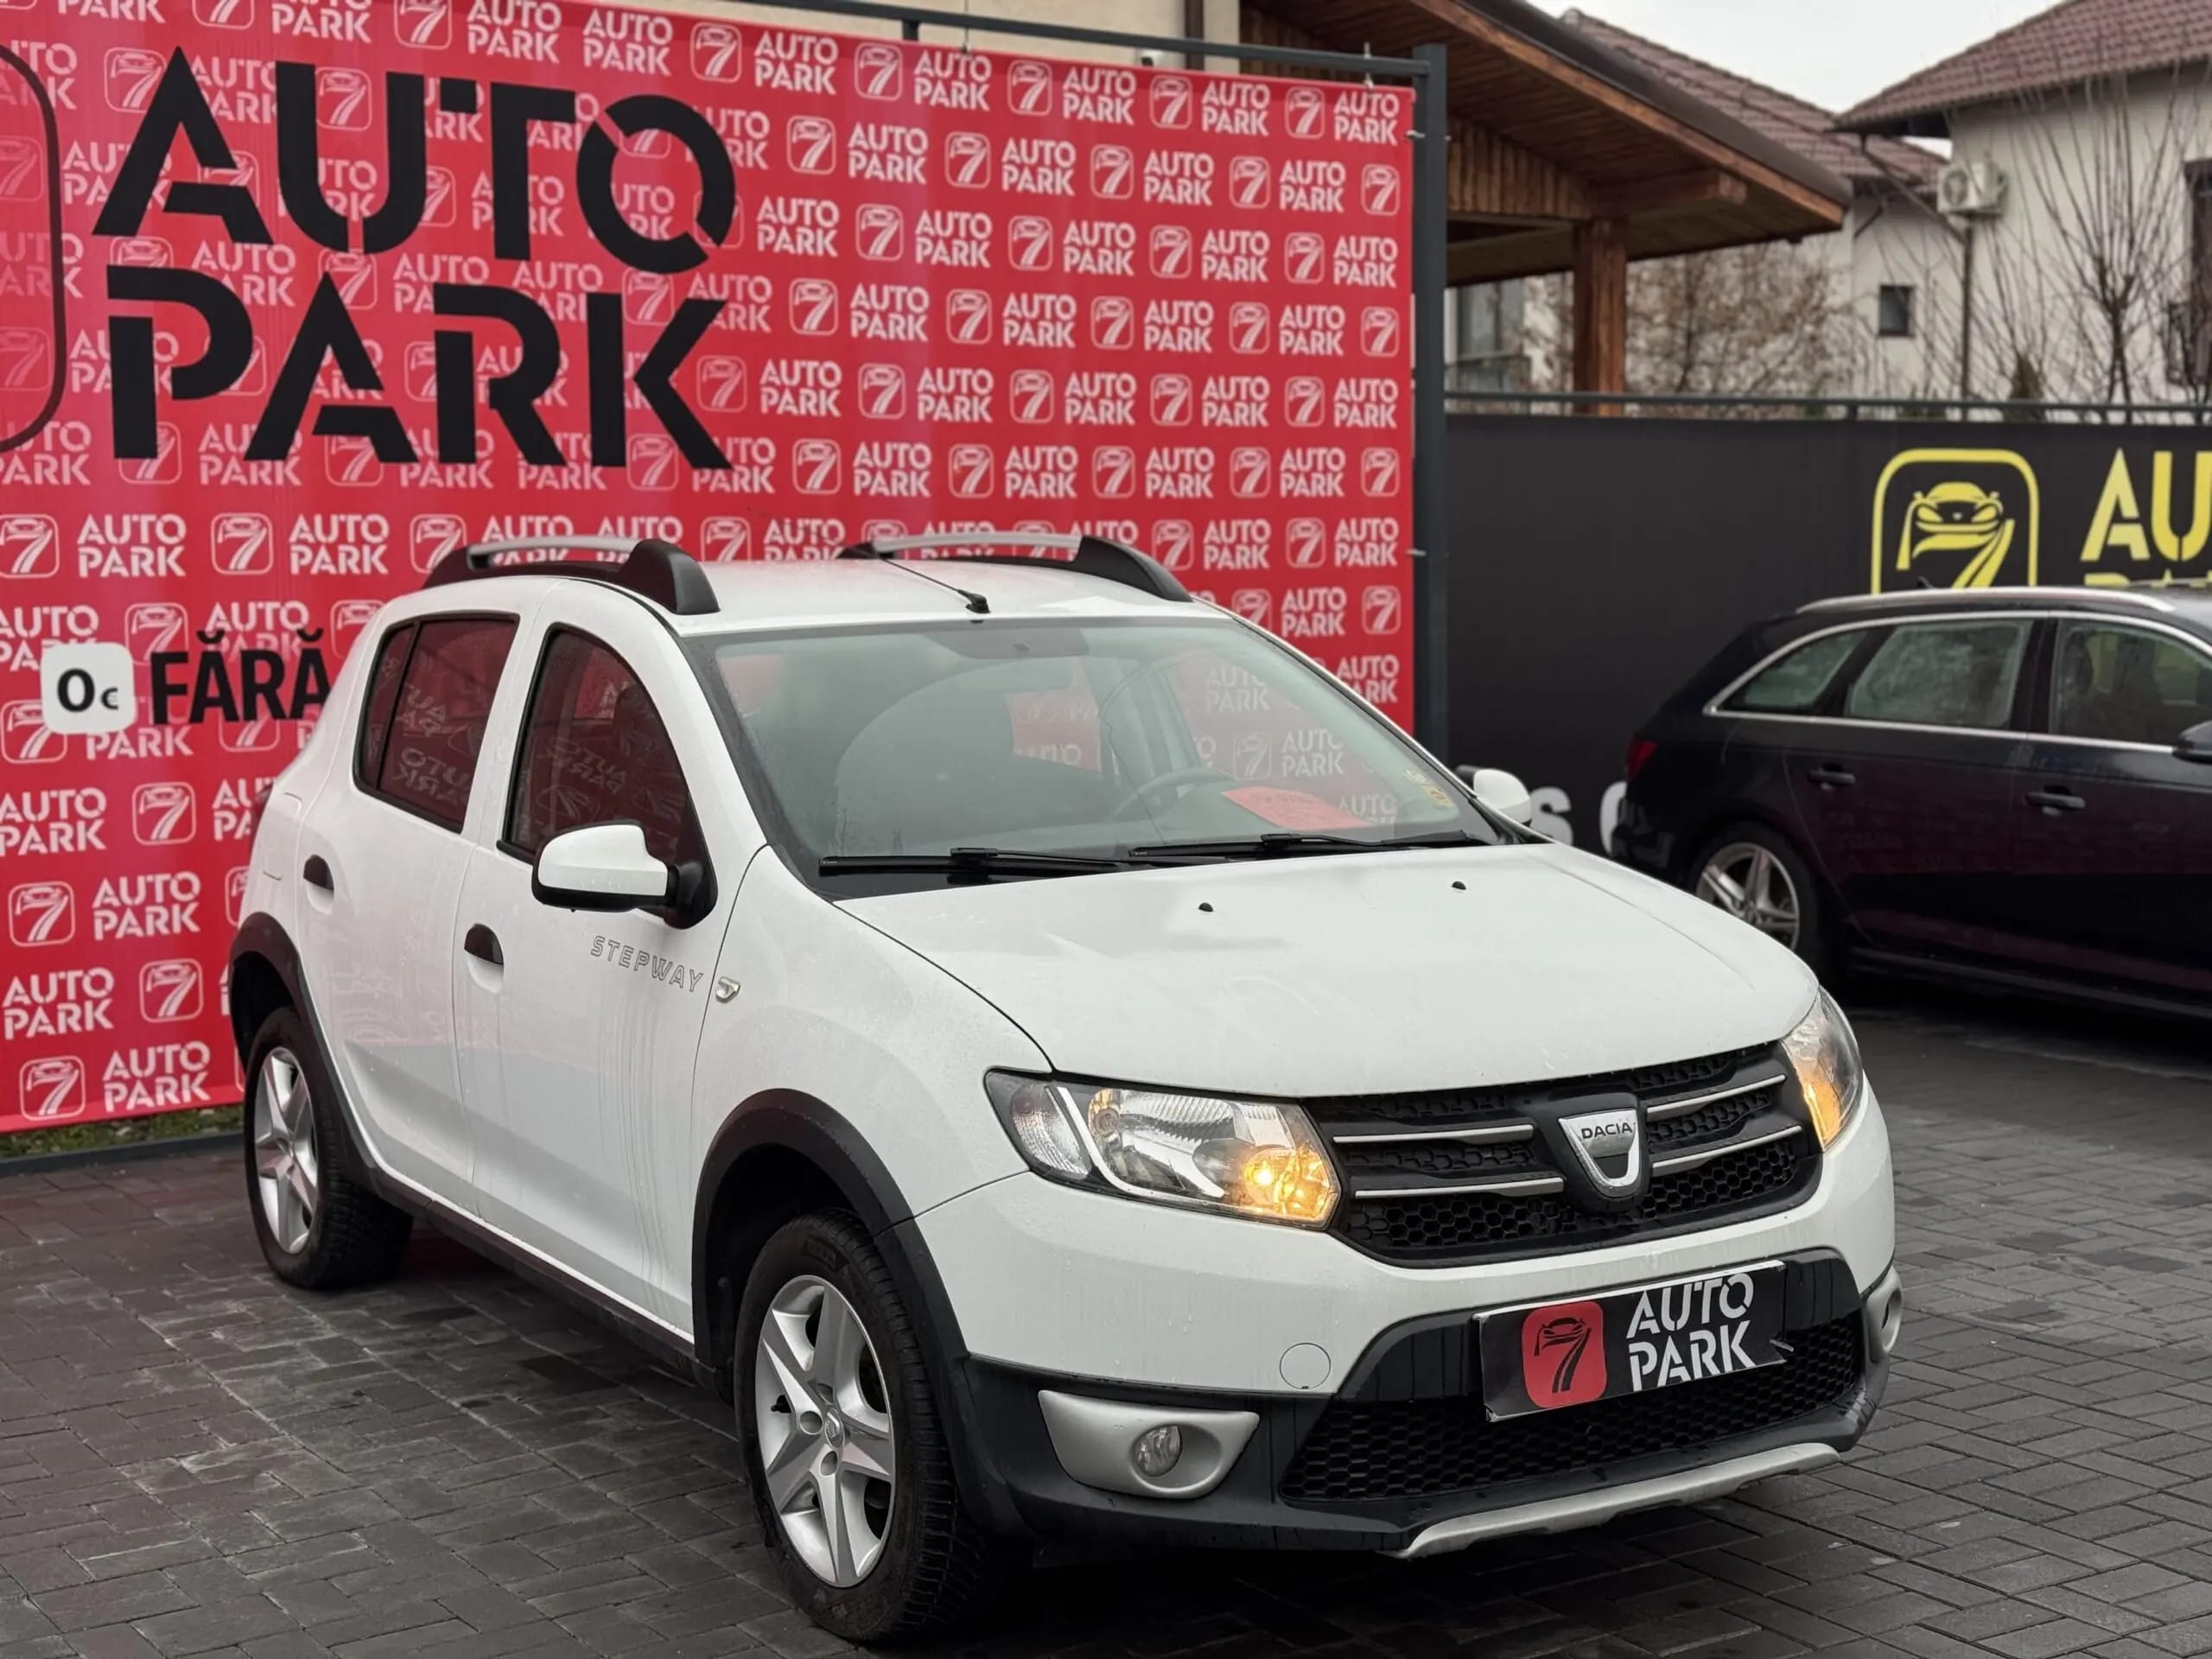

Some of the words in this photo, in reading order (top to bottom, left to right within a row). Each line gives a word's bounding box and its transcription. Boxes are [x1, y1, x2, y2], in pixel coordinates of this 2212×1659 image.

[271, 7, 372, 43] PARK
[467, 0, 562, 33] AUTO
[583, 9, 672, 45] AUTO
[467, 25, 560, 63] PARK
[584, 37, 671, 76] PARK
[755, 31, 837, 64] AUTO
[755, 58, 836, 94] PARK
[915, 50, 991, 83] AUTO
[915, 76, 989, 111] PARK
[1064, 66, 1136, 98] AUTO
[1203, 79, 1270, 110] AUTO
[1064, 92, 1134, 124] PARK
[1335, 91, 1399, 118] AUTO
[1203, 105, 1268, 136] PARK
[1335, 115, 1397, 145] PARK
[849, 123, 928, 156] AUTO
[1002, 138, 1076, 168] AUTO
[92, 47, 735, 273] AUTO
[849, 149, 926, 184] PARK
[1144, 150, 1214, 179] AUTO
[1280, 161, 1345, 188] AUTO
[1002, 164, 1074, 195] PARK
[1144, 175, 1211, 206] PARK
[757, 197, 839, 228] AUTO
[1280, 184, 1344, 213] PARK
[915, 211, 992, 240] AUTO
[1064, 221, 1135, 249] AUTO
[758, 224, 837, 257] PARK
[916, 236, 990, 267] PARK
[1202, 230, 1269, 257] AUTO
[1333, 236, 1398, 262] AUTO
[191, 241, 296, 275] AUTO
[393, 253, 489, 287] AUTO
[1064, 245, 1134, 276] PARK
[1202, 253, 1268, 282] PARK
[512, 260, 603, 292] AUTO
[689, 273, 772, 302] AUTO
[1334, 260, 1396, 288] PARK
[850, 283, 929, 314] AUTO
[1003, 294, 1077, 321] AUTO
[851, 310, 928, 341] PARK
[1144, 301, 1213, 327] AUTO
[1279, 305, 1345, 330] AUTO
[1004, 319, 1075, 347] PARK
[1145, 325, 1211, 353] PARK
[1280, 329, 1344, 355] PARK
[106, 266, 733, 469] PARK
[760, 359, 842, 388] AUTO
[918, 368, 994, 395] AUTO
[1065, 372, 1136, 399] AUTO
[1202, 376, 1269, 401] AUTO
[1334, 378, 1398, 404] AUTO
[761, 387, 840, 416] PARK
[918, 393, 992, 422] PARK
[1065, 397, 1135, 425] PARK
[1203, 401, 1268, 426] PARK
[1334, 402, 1396, 428] PARK
[854, 442, 931, 470] AUTO
[1005, 446, 1078, 472] AUTO
[1146, 448, 1214, 472] AUTO
[1281, 448, 1345, 472] AUTO
[855, 467, 930, 497] PARK
[1006, 472, 1077, 498] PARK
[1146, 472, 1212, 498] PARK
[1281, 472, 1344, 497] PARK
[78, 514, 186, 544] AUTO
[289, 514, 389, 543] AUTO
[765, 520, 845, 548] AUTO
[1204, 519, 1271, 544] AUTO
[1335, 518, 1399, 542] AUTO
[79, 546, 185, 577] PARK
[290, 544, 387, 574] PARK
[1204, 544, 1268, 569] PARK
[1335, 542, 1396, 567] PARK
[1281, 587, 1346, 612] AUTO
[206, 601, 309, 637] AUTO
[1281, 613, 1344, 637] PARK
[150, 627, 332, 725] FĂRĂ
[1336, 655, 1400, 679] AUTO
[86, 724, 193, 760] PARK
[1282, 753, 1344, 776] PARK
[92, 872, 200, 908] AUTO
[94, 902, 200, 940] PARK
[590, 935, 704, 993] STEPWAY
[103, 1041, 210, 1081] AUTO
[105, 1072, 210, 1113] PARK
[1580, 1122, 1633, 1139] DACIA
[1626, 1274, 1754, 1339] AUTO
[1629, 1320, 1756, 1391] PARK
